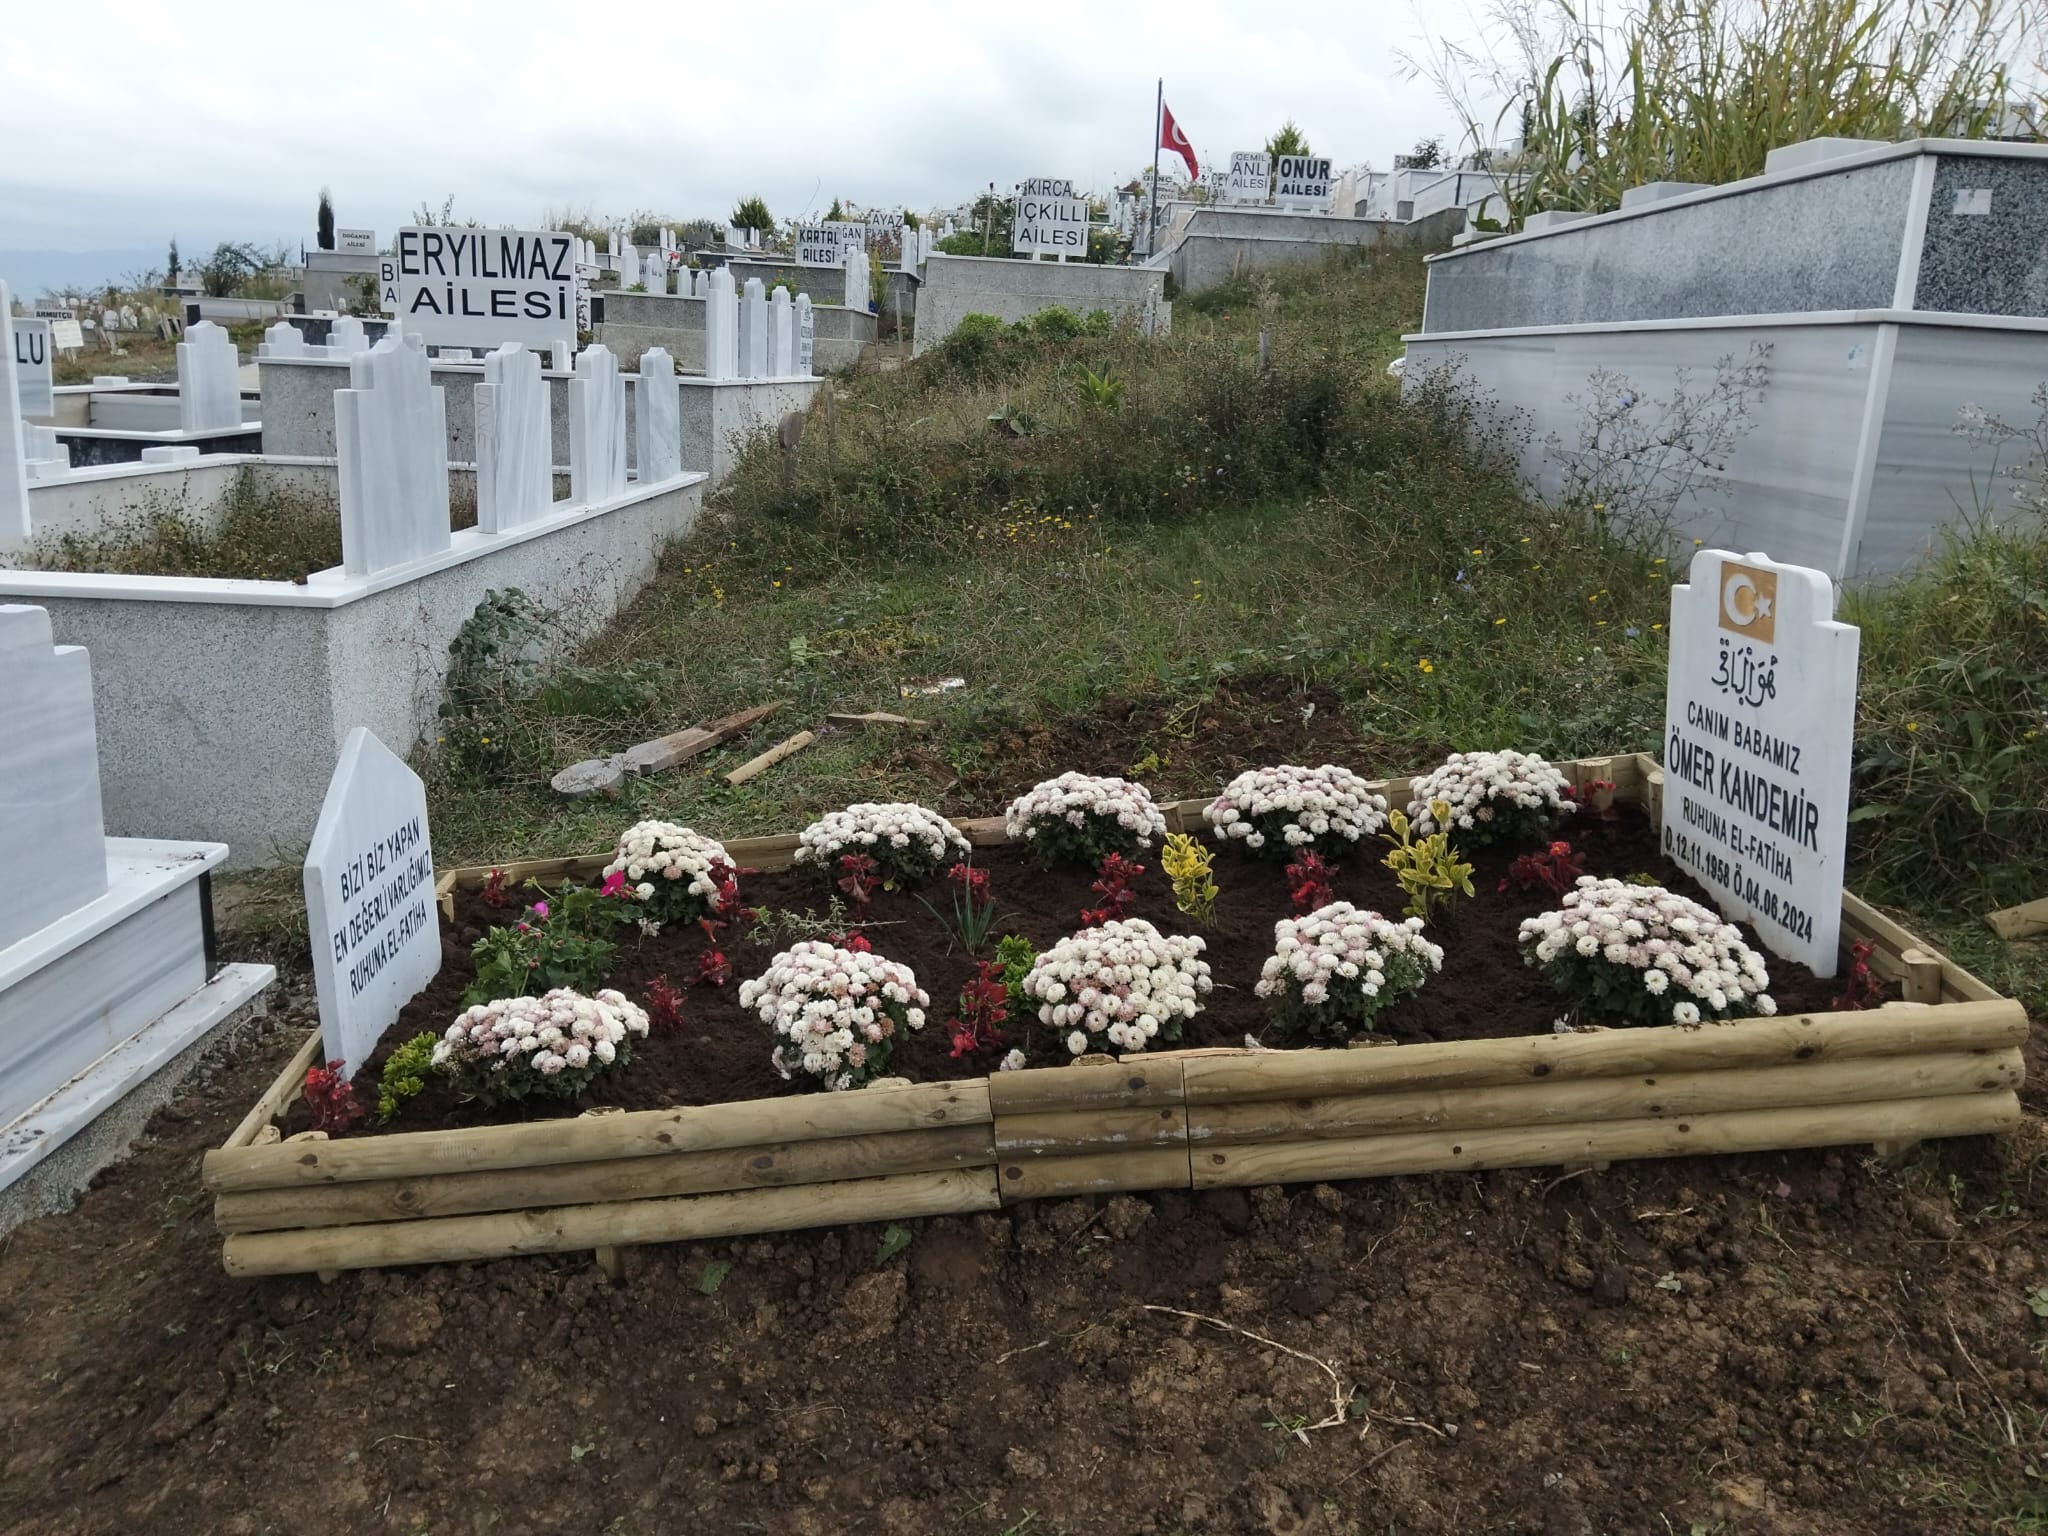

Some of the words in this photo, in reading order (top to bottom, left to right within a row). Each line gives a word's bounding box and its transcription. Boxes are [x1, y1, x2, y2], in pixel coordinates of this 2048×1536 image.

[1231, 161, 1271, 176] ANLI
[1281, 158, 1330, 180] ONUR
[1028, 179, 1072, 197] KIRCA
[1281, 180, 1326, 197] AİLESİ
[873, 214, 903, 228] AYAZ
[1018, 199, 1088, 223] İÇKİLLİ
[800, 229, 839, 245] KARTAL
[1019, 226, 1084, 246] AİLESİ
[400, 232, 571, 281] ERYILMAZ
[803, 245, 835, 263] AİLESİ
[410, 282, 566, 320] AİLESİ
[1688, 701, 1728, 741] CANIM
[1735, 721, 1800, 775] BABAMIZ
[1670, 725, 1714, 794] ÖMER
[1721, 758, 1819, 852] KANDEMİR
[1683, 797, 1727, 844] RUHUNA
[1731, 824, 1792, 885] EL-FATİHA
[341, 853, 365, 903] BİZİ
[367, 842, 386, 882] BİZ
[387, 816, 420, 864] YAPAN
[334, 926, 348, 963] EN
[350, 884, 389, 949] DEĞERLİ
[387, 850, 431, 907] VARLIĞIMIZ
[350, 939, 388, 999] RUHUNA
[387, 899, 427, 960] EL-FATİHA
